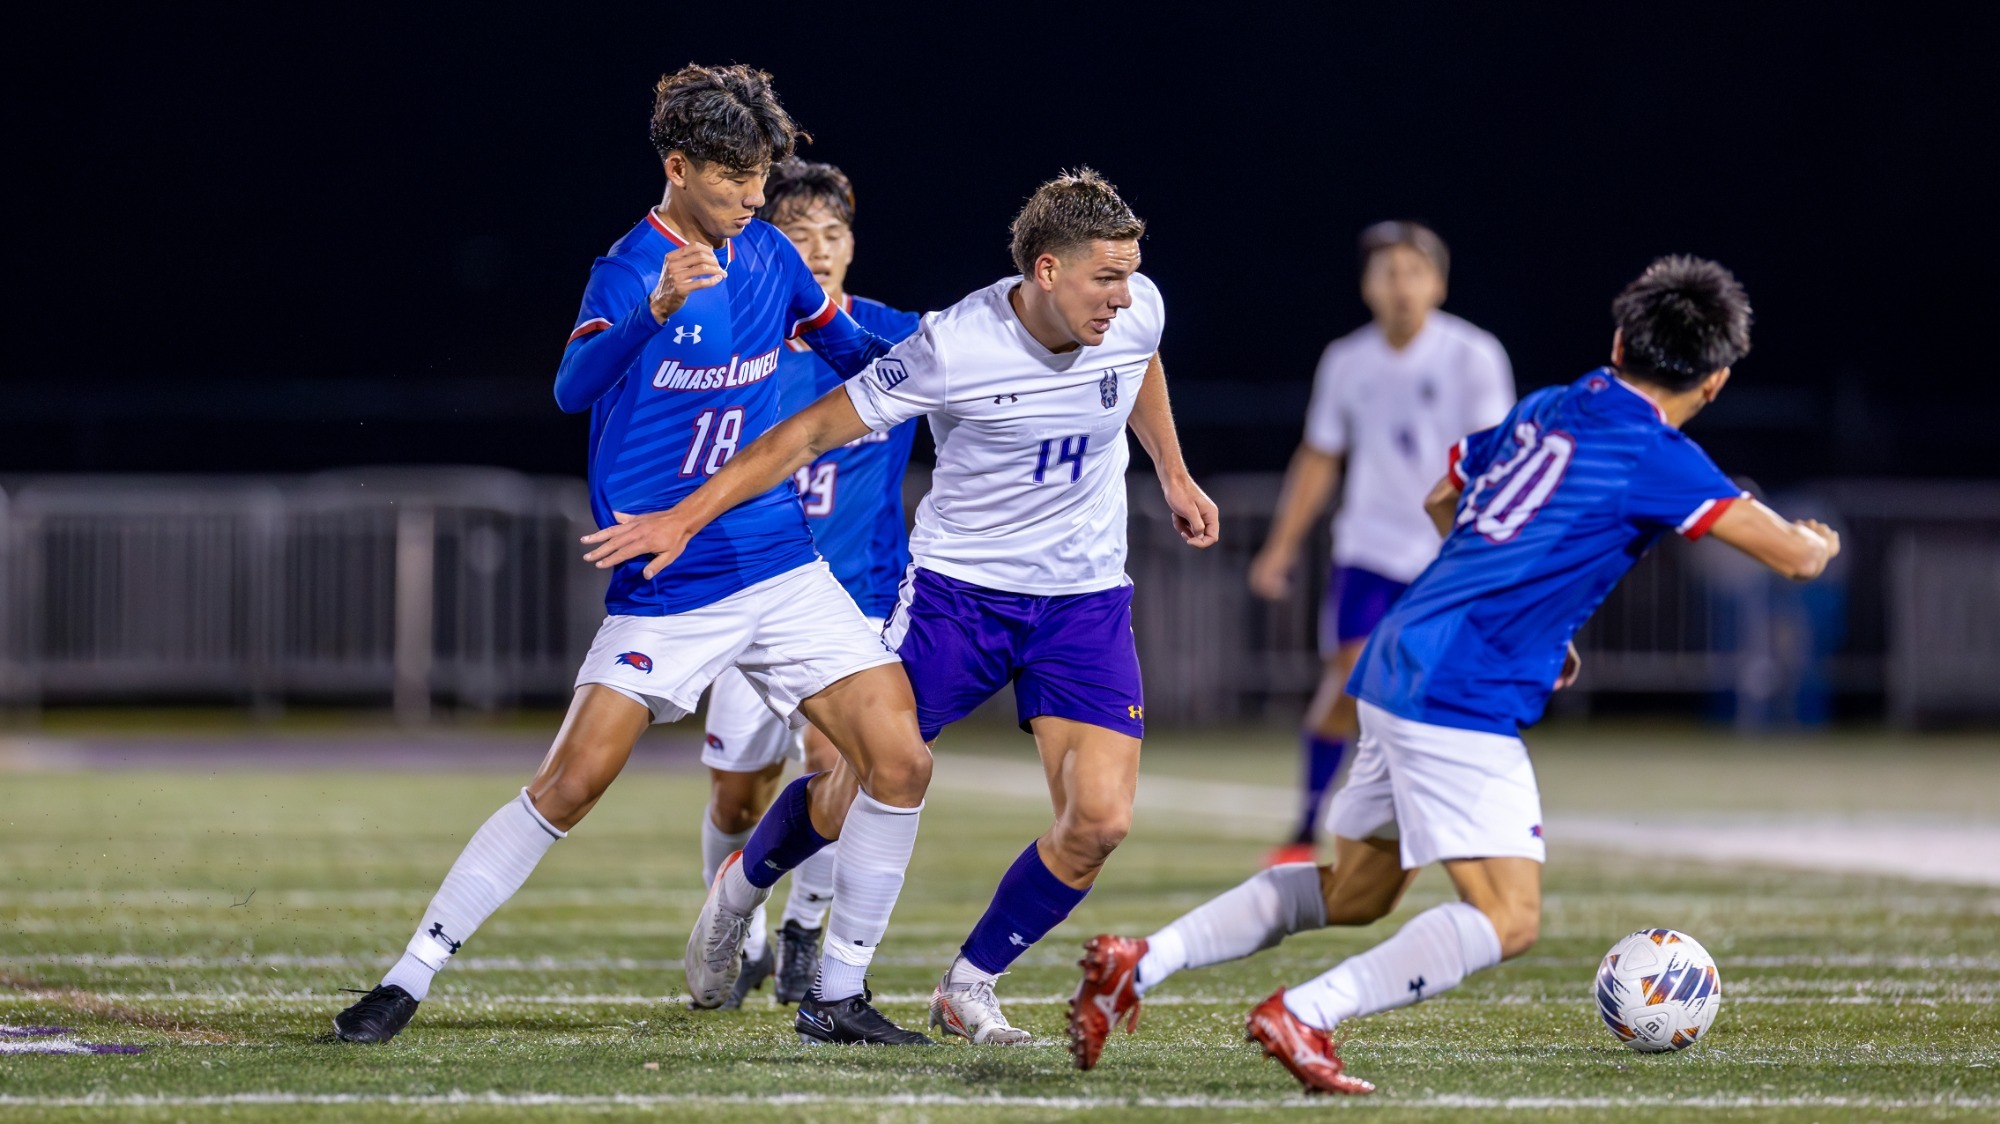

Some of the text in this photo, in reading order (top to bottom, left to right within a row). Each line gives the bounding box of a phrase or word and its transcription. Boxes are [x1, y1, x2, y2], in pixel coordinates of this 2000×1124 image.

[680, 407, 744, 477] 18
[1033, 434, 1090, 484] 14
[1456, 421, 1573, 542] 20
